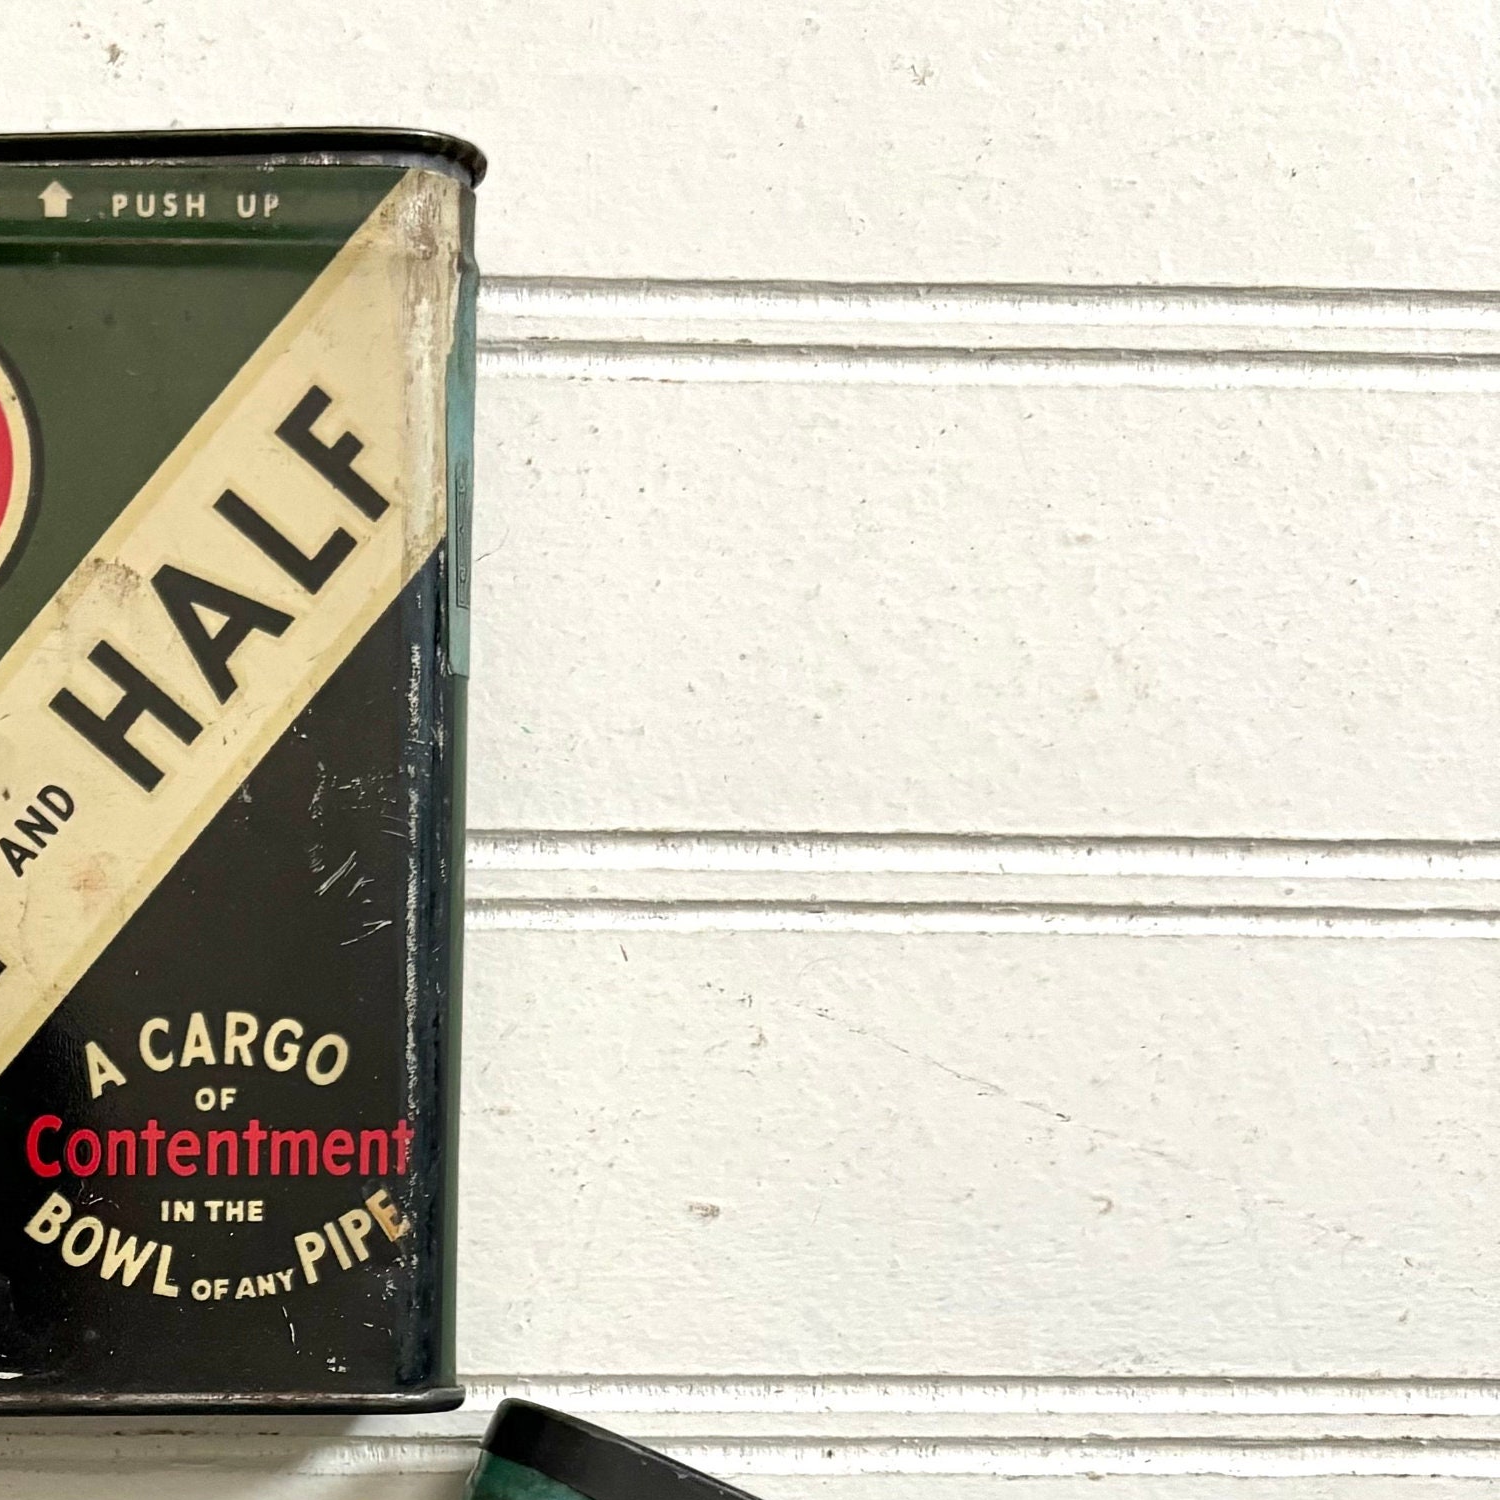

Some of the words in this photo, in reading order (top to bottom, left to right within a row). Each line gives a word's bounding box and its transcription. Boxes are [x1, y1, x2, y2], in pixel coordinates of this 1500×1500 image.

[111, 192, 206, 218] PUSH
[236, 193, 280, 218] UP
[48, 384, 391, 793] HALF
[84, 1041, 127, 1099] A
[138, 1011, 349, 1086] CARGO
[195, 1087, 237, 1111] OF
[25, 1114, 415, 1177] Contentment
[161, 1200, 194, 1222] IN
[204, 1200, 263, 1222] THE
[23, 1191, 178, 1298] BOWL
[190, 1278, 229, 1301] OF
[235, 1268, 294, 1298] ANY
[294, 1188, 409, 1284] PIPE
